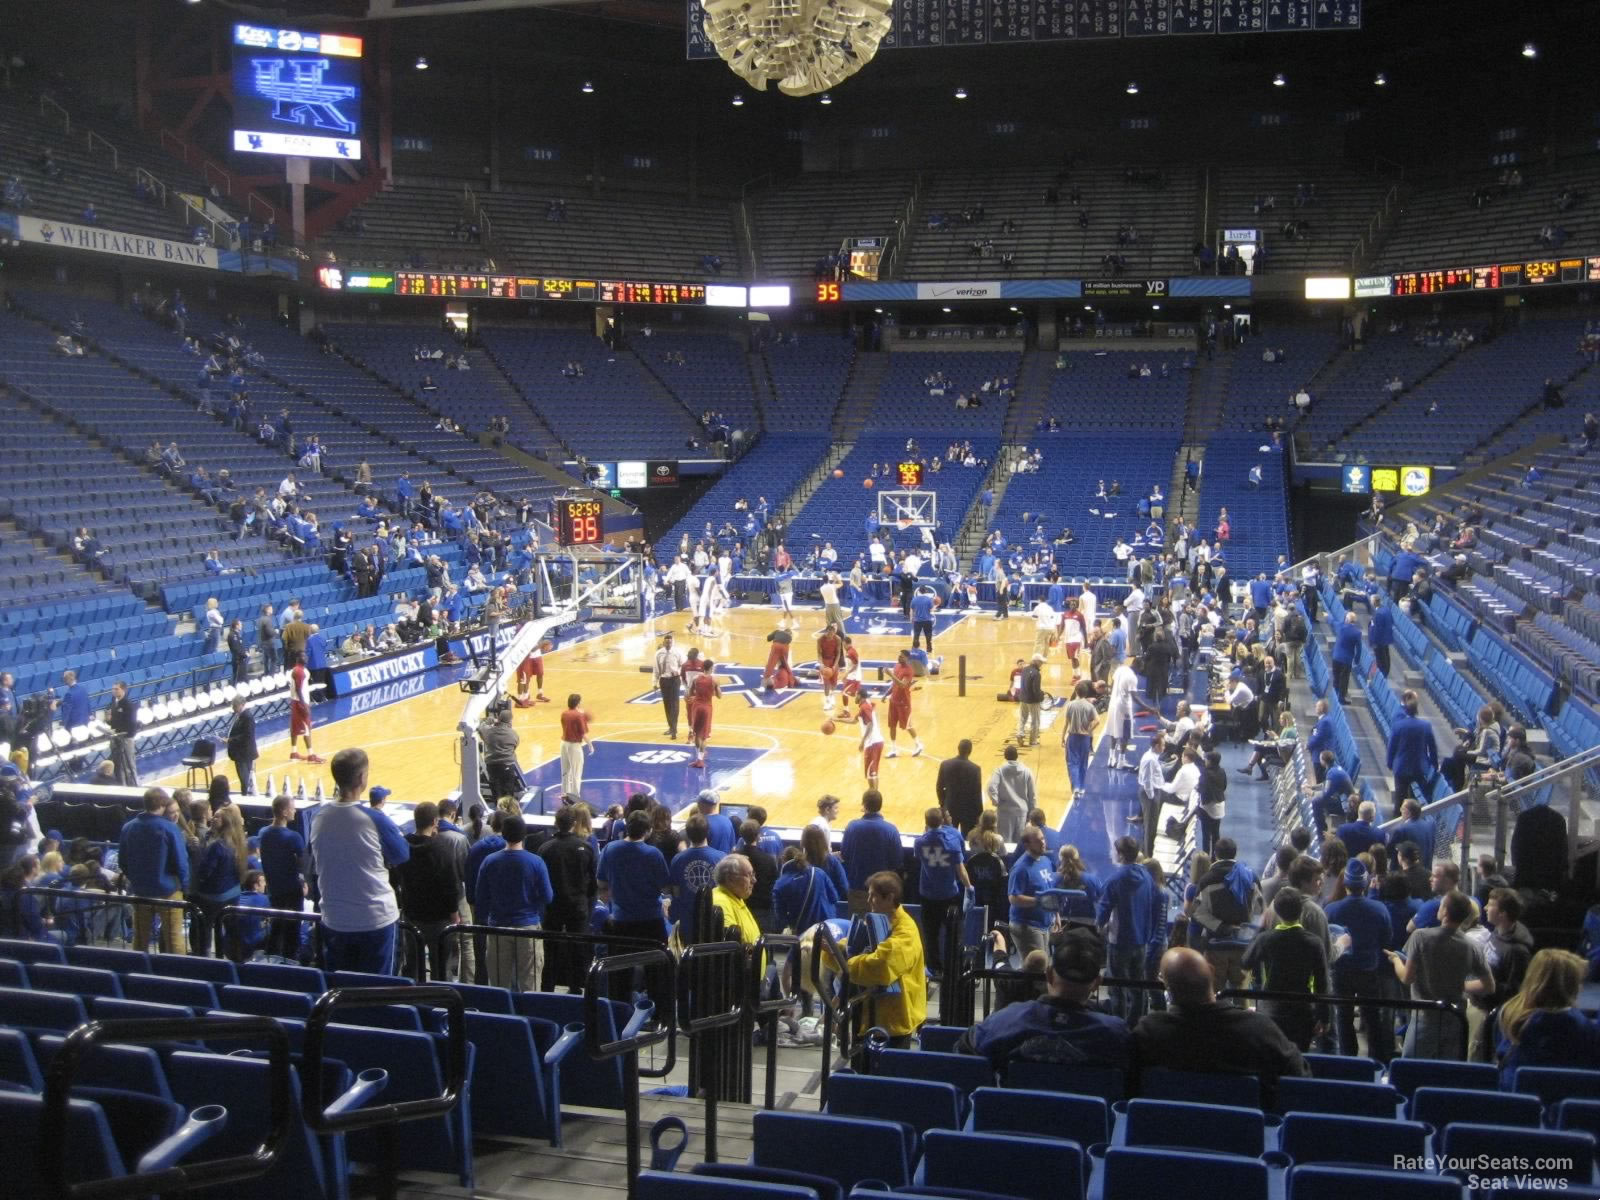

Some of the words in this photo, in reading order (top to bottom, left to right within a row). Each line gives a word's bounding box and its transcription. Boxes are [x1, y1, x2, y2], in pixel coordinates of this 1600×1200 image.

[903, 0, 913, 33] CAA
[1020, 3, 1031, 37] 978
[1064, 3, 1074, 36] 984
[1108, 1, 1118, 34] 993
[1157, 0, 1167, 32] 996
[60, 226, 157, 257] WHITAKER
[164, 243, 207, 265] BANK
[818, 284, 839, 301] 35
[956, 287, 988, 296] verizon
[1147, 281, 1165, 293] yp
[898, 464, 921, 472] 52:54
[902, 471, 917, 485] 35
[568, 503, 600, 518] 52:54
[573, 517, 597, 542] 35
[349, 650, 425, 690] KENTUCKY
[628, 749, 692, 764] SEC
[921, 845, 951, 867] UK
[1040, 869, 1053, 883] UK
